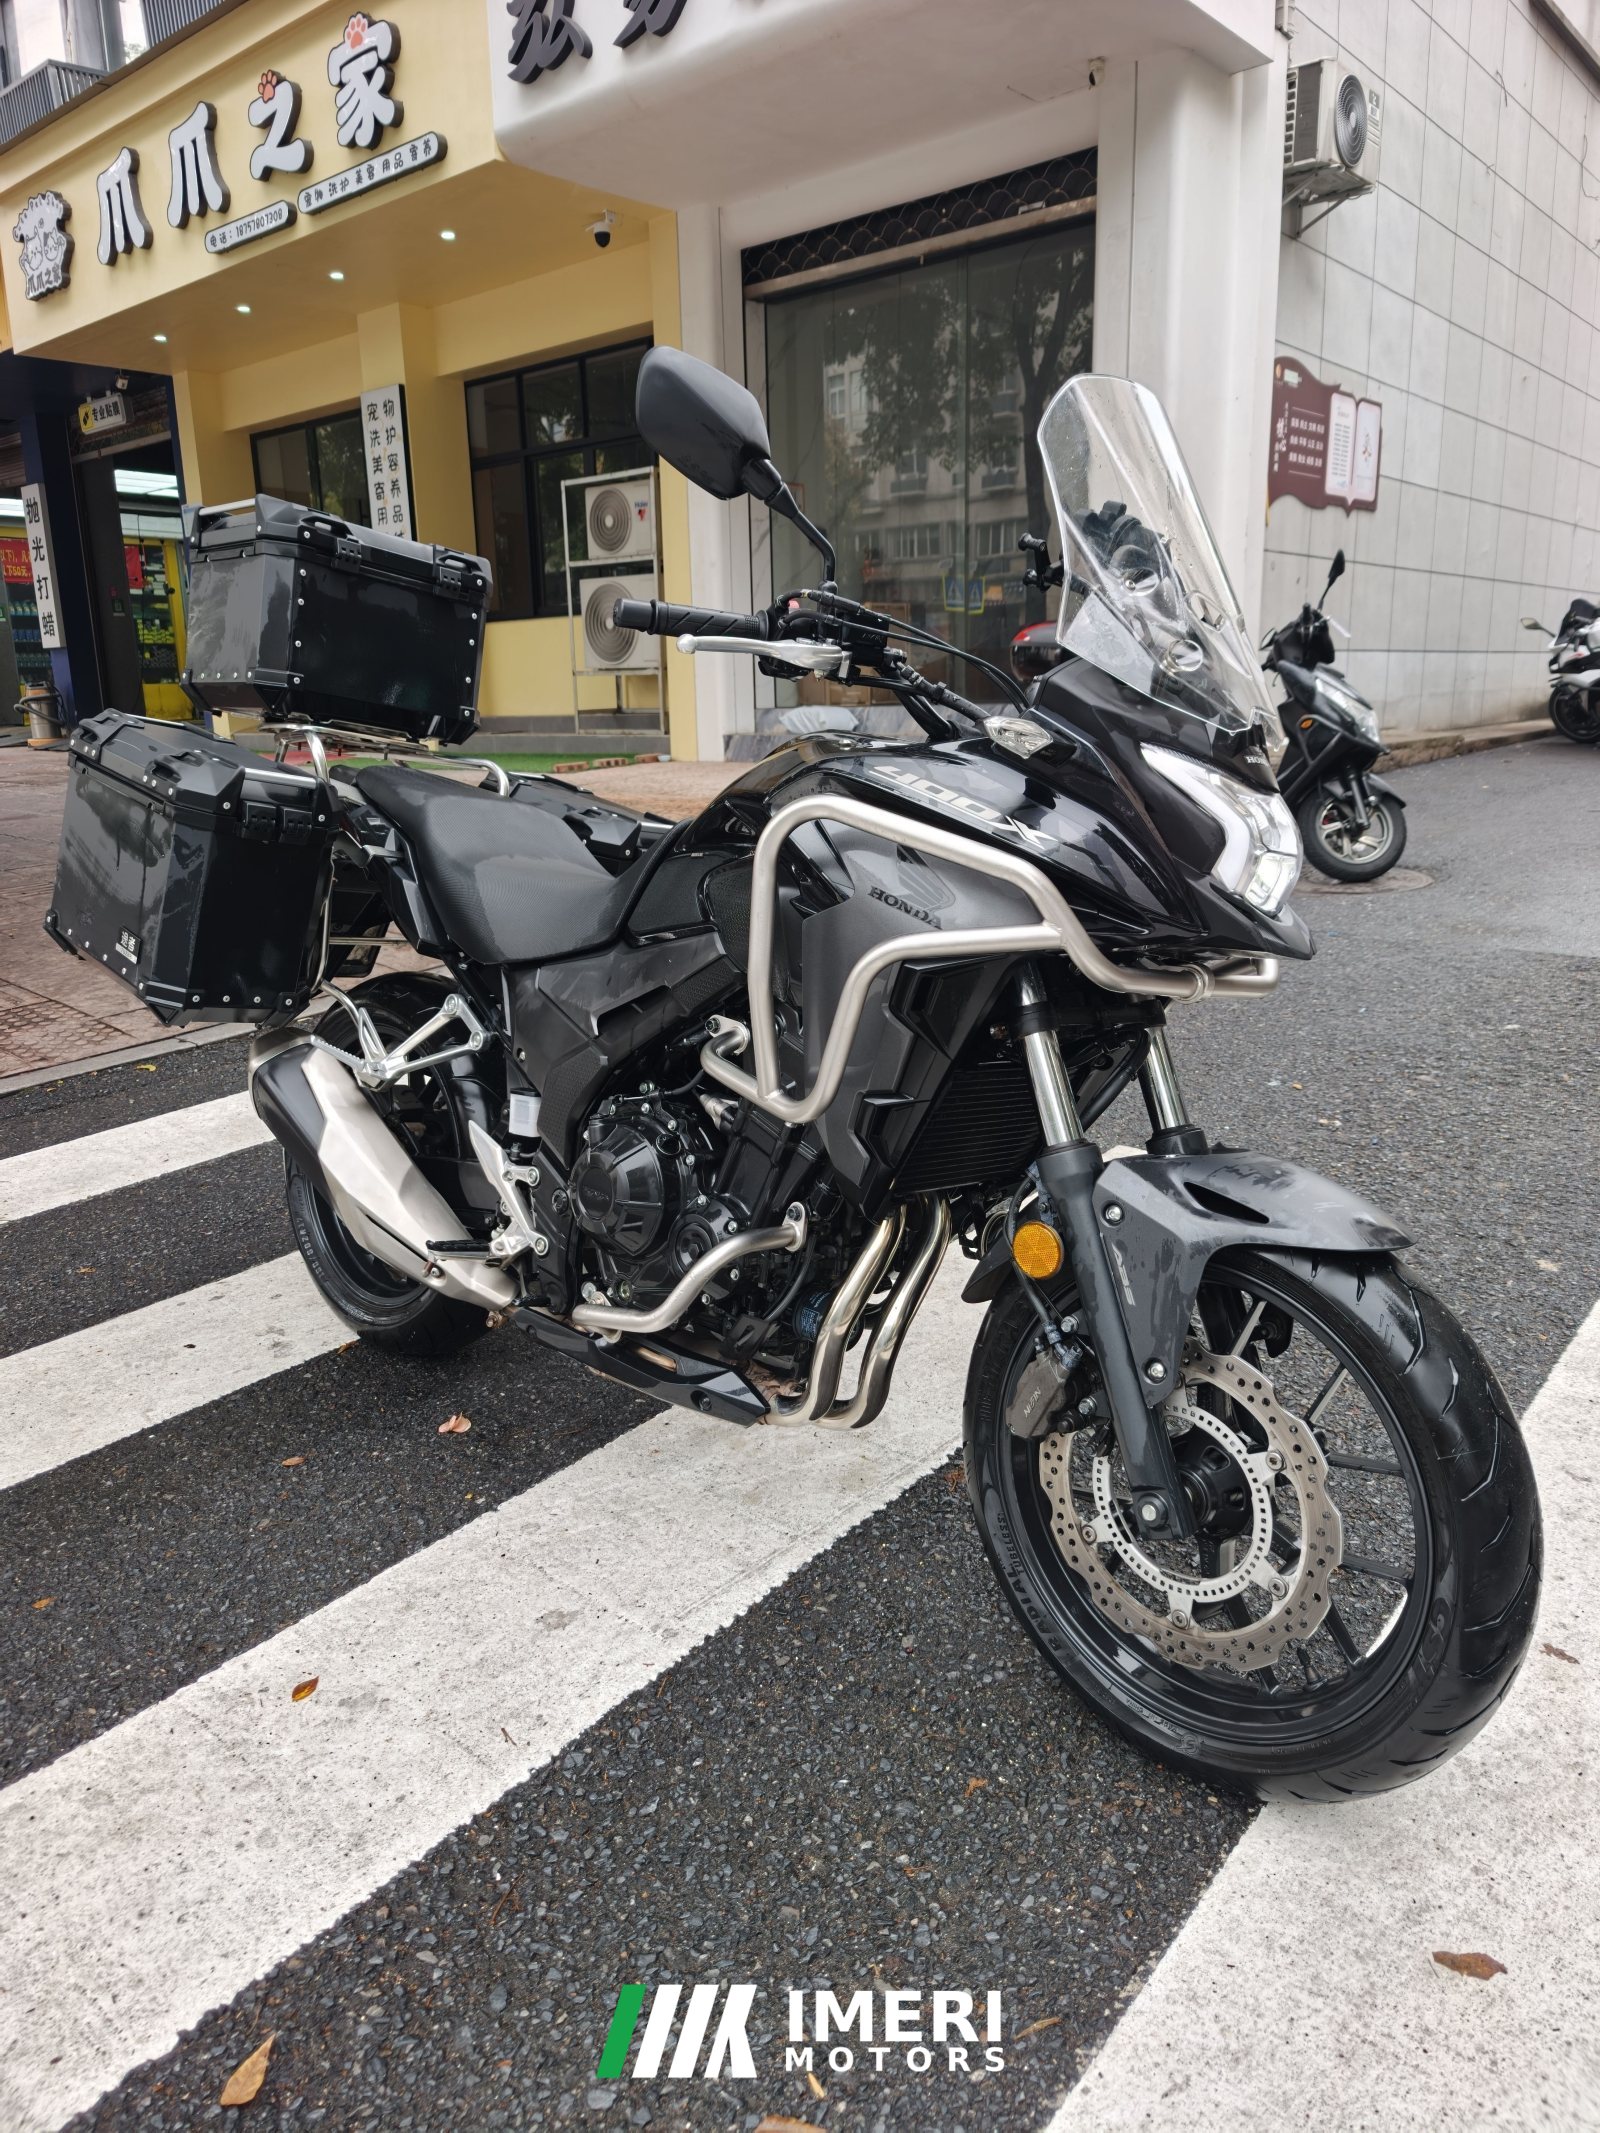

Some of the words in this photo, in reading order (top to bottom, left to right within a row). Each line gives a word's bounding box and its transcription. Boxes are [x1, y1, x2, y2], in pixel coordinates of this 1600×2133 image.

[97, 12, 404, 266] 爪爪之家
[328, 177, 349, 197] 洗护
[355, 164, 375, 185] 美容
[382, 151, 404, 174] 用品
[27, 263, 61, 296] 爪爪之家
[369, 424, 397, 448] 洗护
[371, 453, 399, 475] 美容
[374, 478, 402, 501] 寄养
[377, 504, 404, 526] 用品
[26, 497, 56, 637] 抛光打蜡
[867, 885, 943, 930] HONDA
[1111, 1243, 1136, 1306] ABS
[997, 1512, 1025, 1576] TUBELESS
[1007, 1563, 1062, 1652] RADIAL
